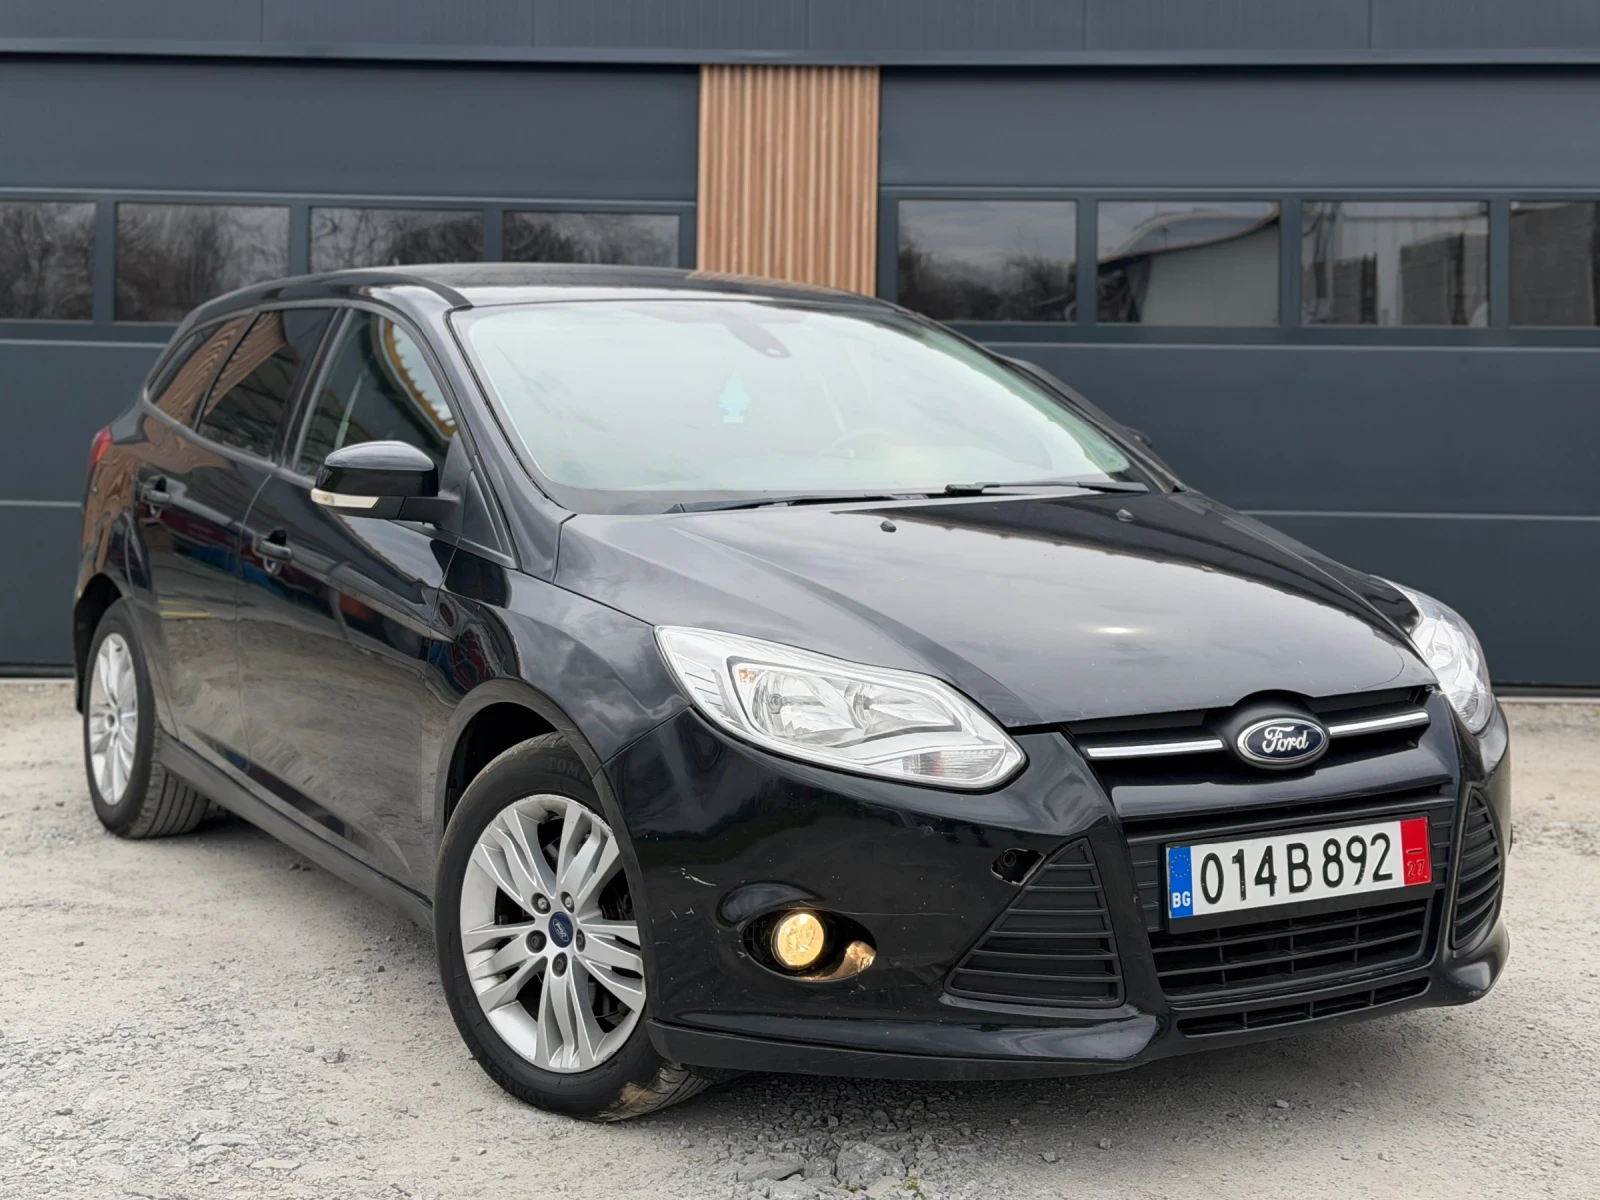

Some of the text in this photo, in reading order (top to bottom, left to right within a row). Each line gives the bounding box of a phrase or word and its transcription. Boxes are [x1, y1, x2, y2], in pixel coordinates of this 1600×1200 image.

[1262, 726, 1309, 753] Ford
[1200, 832, 1393, 905] 014B892
[1407, 859, 1425, 878] 27
[1172, 891, 1191, 908] BG
